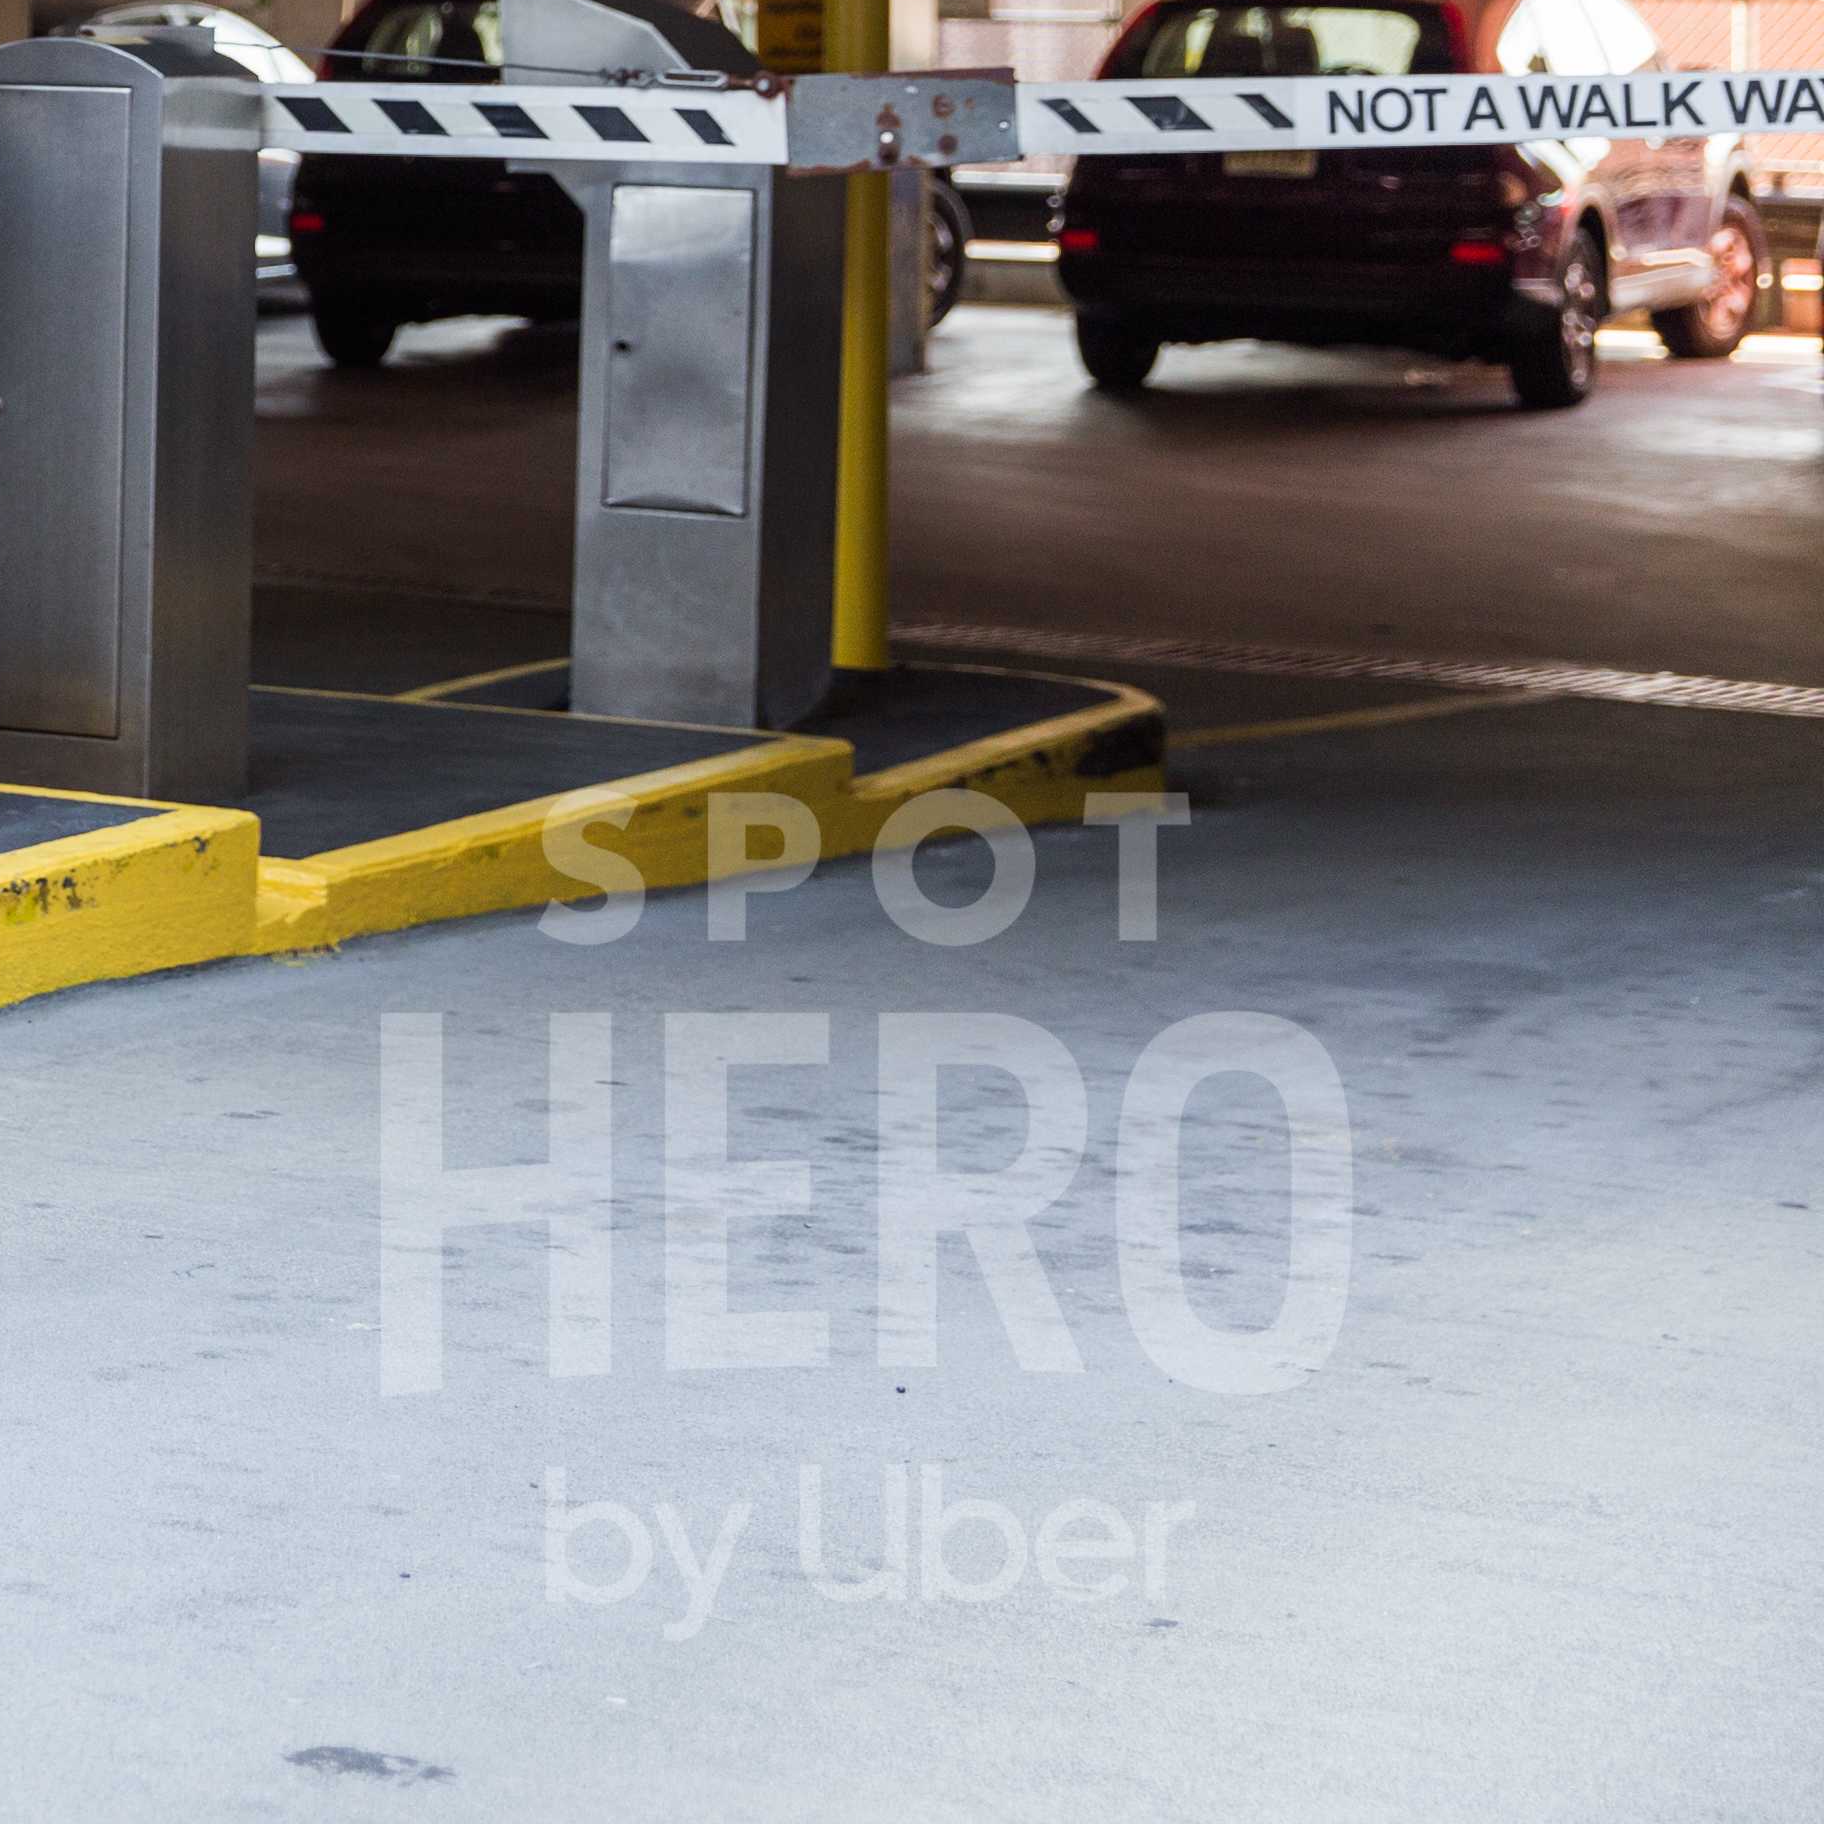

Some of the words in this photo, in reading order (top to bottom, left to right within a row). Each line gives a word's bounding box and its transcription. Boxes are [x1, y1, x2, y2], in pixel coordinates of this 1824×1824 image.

[1328, 87, 1448, 134] NOT
[1464, 85, 1504, 130] A
[1518, 80, 1704, 130] WALK
[1723, 77, 1824, 124] WA
